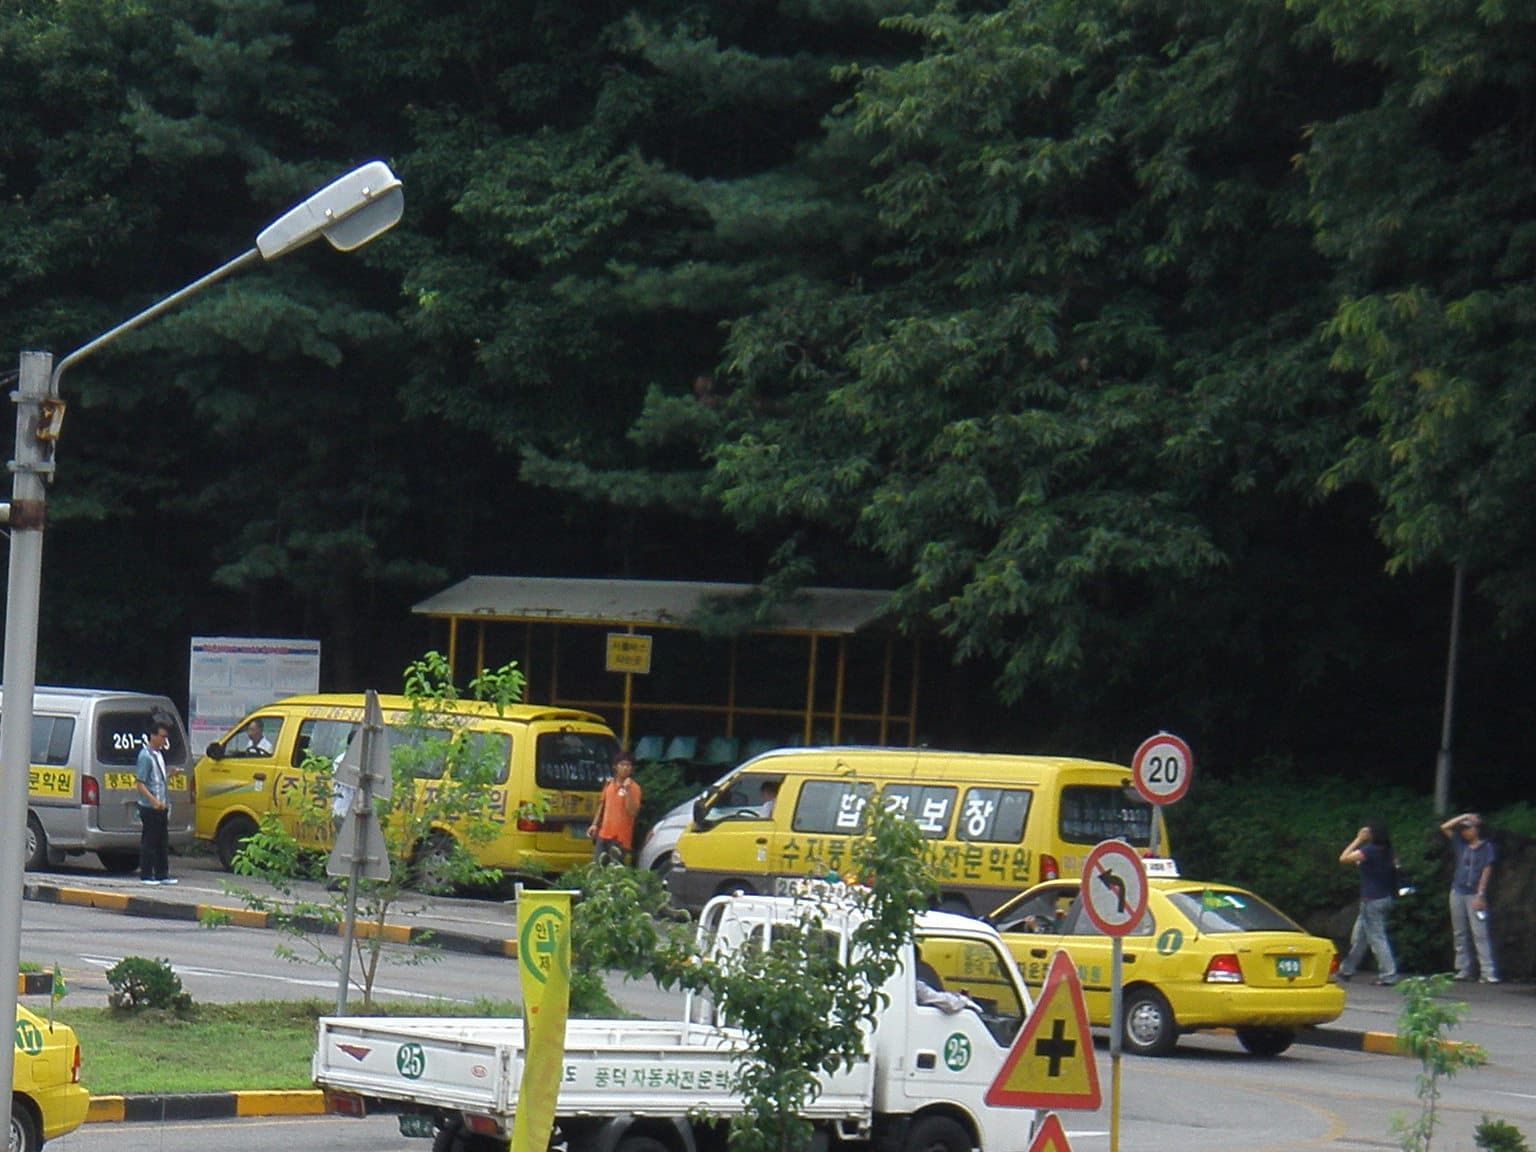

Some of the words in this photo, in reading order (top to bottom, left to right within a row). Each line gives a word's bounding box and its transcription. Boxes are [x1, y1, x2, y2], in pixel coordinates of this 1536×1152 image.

[113, 733, 170, 750] 261-33
[1149, 757, 1178, 783] 20
[16, 1024, 39, 1051] 17
[401, 1046, 421, 1075] 25
[949, 1039, 968, 1067] 25
